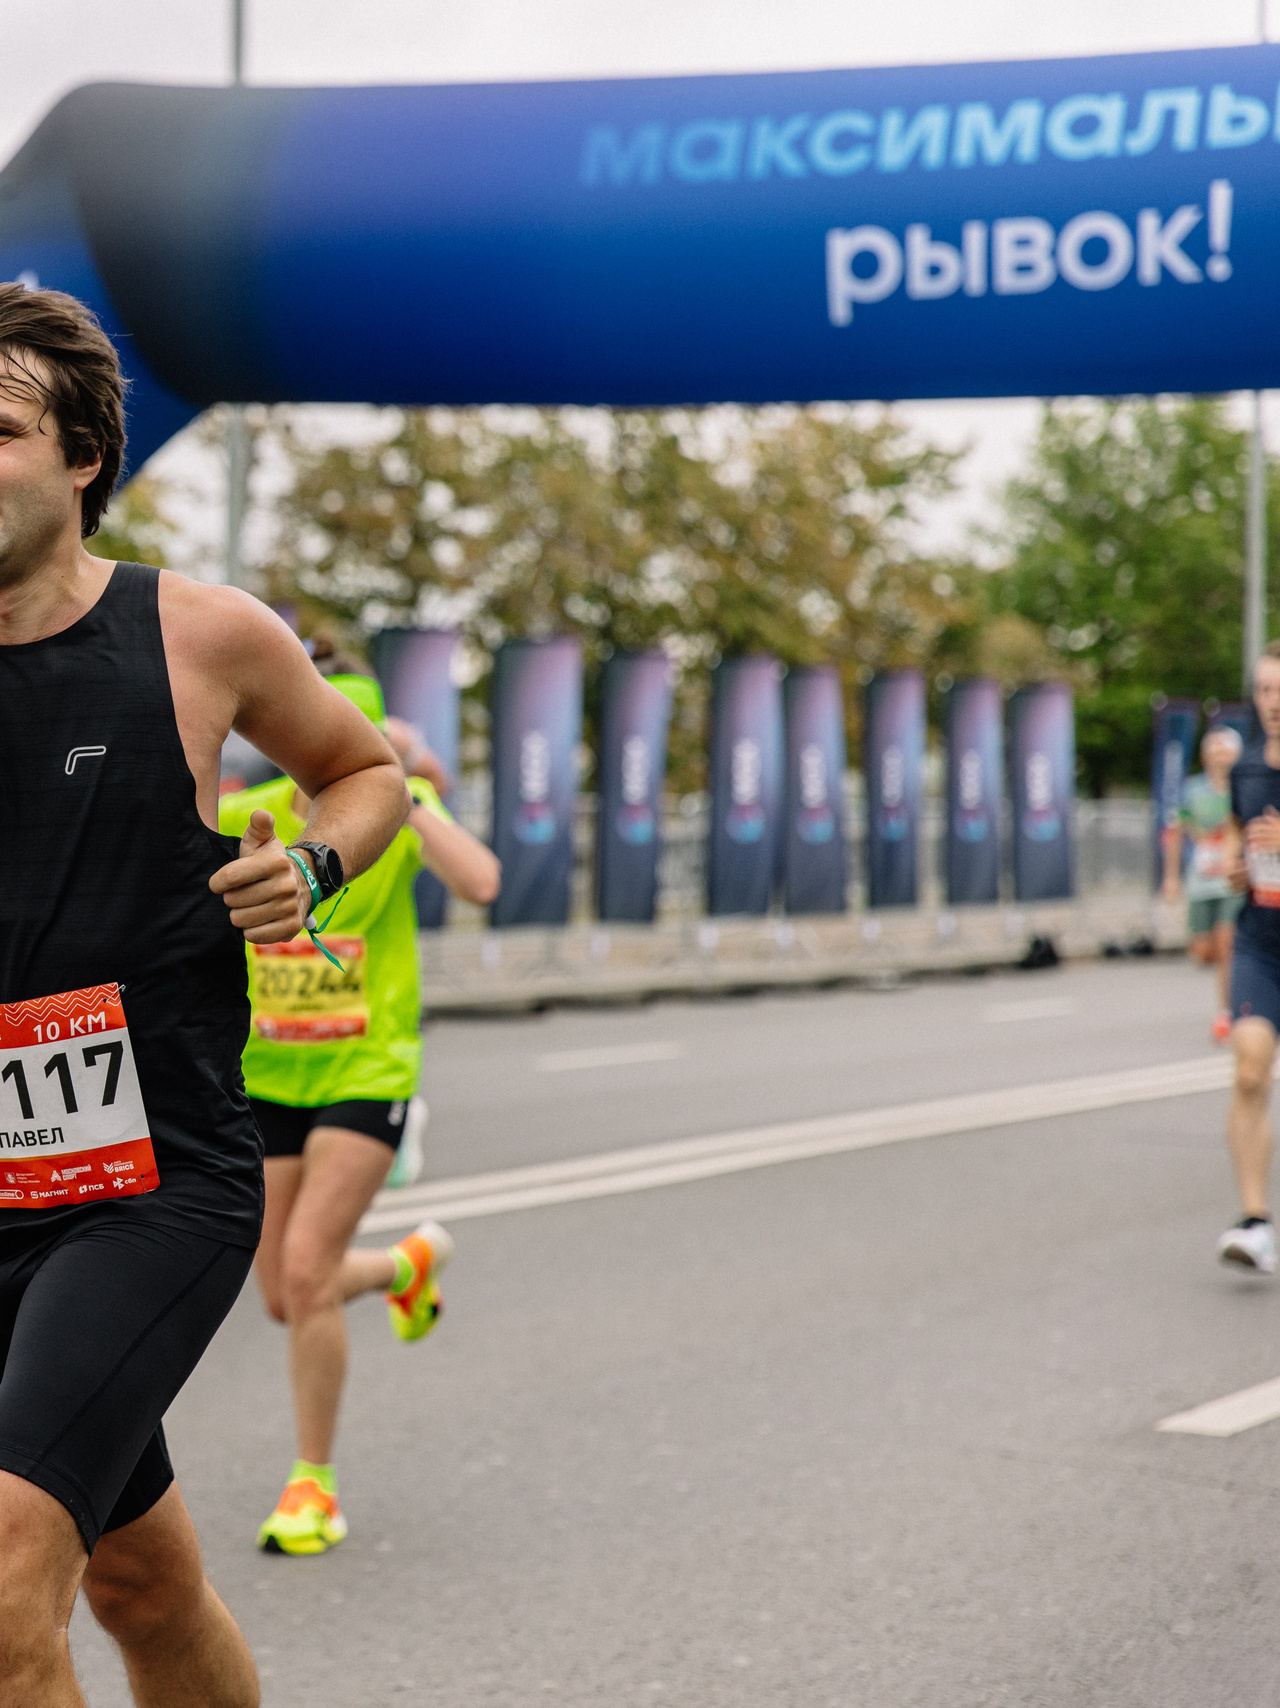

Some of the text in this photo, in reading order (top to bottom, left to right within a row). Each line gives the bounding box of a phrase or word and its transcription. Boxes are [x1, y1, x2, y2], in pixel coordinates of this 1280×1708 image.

[580, 82, 1280, 188] максималь
[824, 177, 1235, 328] рывок!
[33, 1021, 60, 1043] 10
[114, 1163, 135, 1173] BRICS
[39, 1189, 69, 1198] МАГНИТ
[88, 1183, 105, 1191] ПСБ
